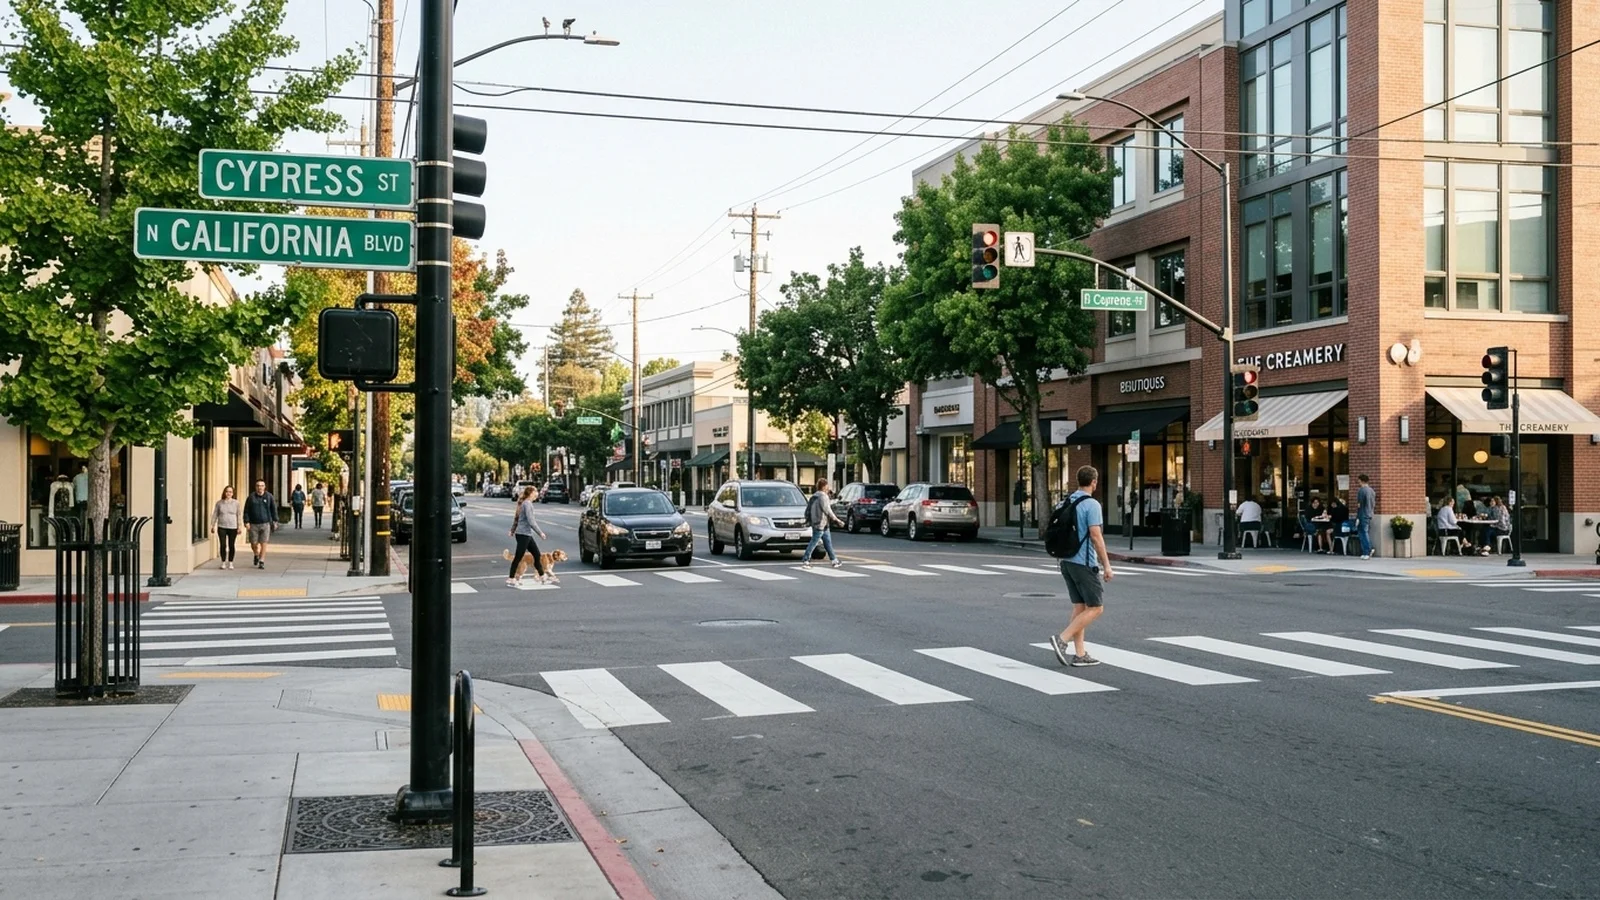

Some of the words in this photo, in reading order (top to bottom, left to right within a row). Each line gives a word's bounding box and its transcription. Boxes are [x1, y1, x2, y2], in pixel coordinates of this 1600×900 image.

[215, 158, 363, 197] CYPRESS
[377, 173, 399, 192] ST
[146, 224, 158, 242] N
[171, 218, 354, 258] CALIFORNIA
[364, 235, 404, 252] BLVD
[1266, 343, 1344, 370] CREAMERY
